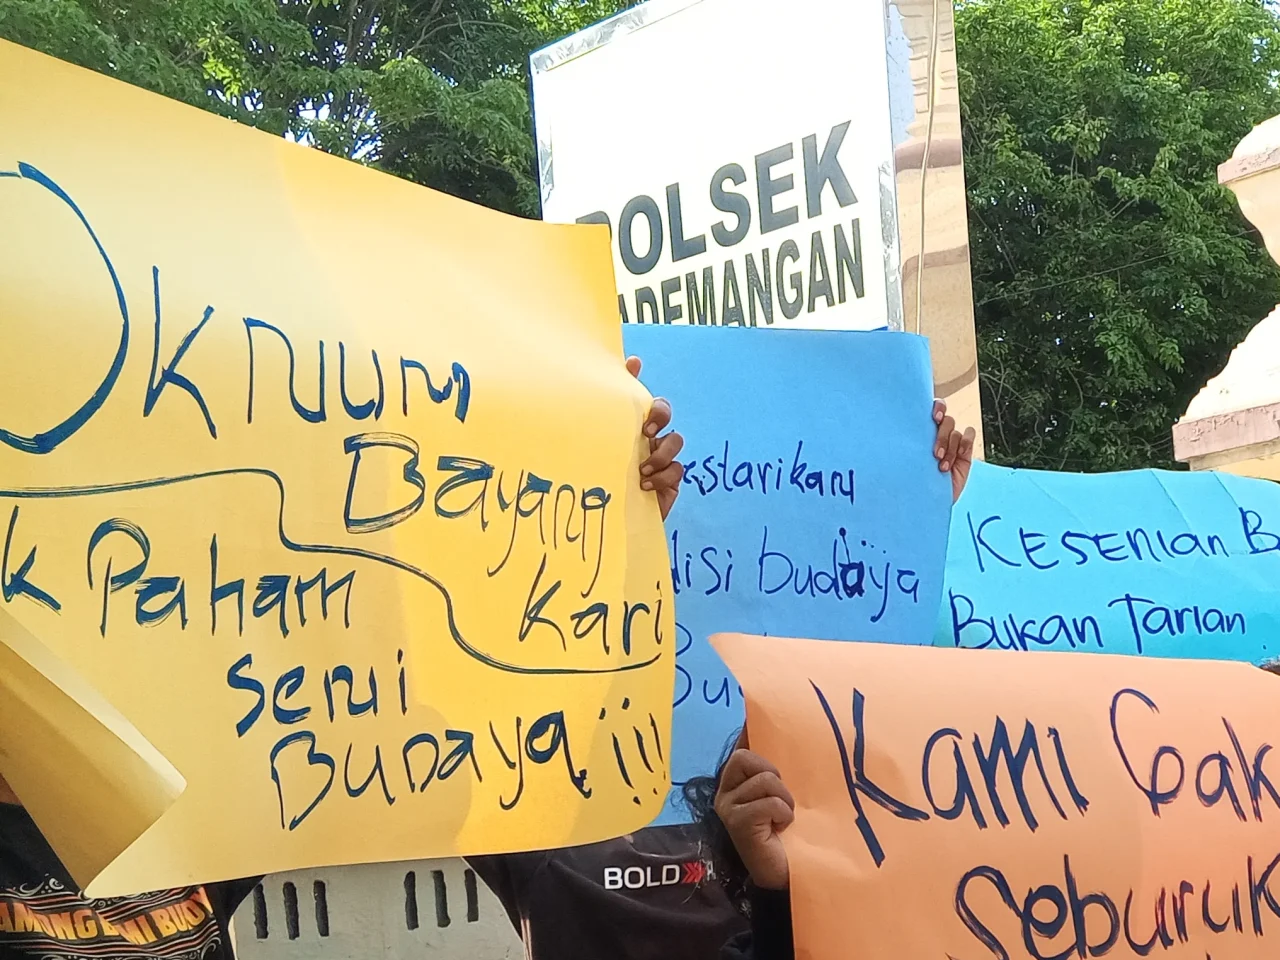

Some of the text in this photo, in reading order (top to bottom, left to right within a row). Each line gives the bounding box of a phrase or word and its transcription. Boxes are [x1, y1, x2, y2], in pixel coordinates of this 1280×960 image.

[683, 440, 856, 505] estarikan
[808, 677, 1090, 868] Kami
[604, 864, 681, 890] BOLD
